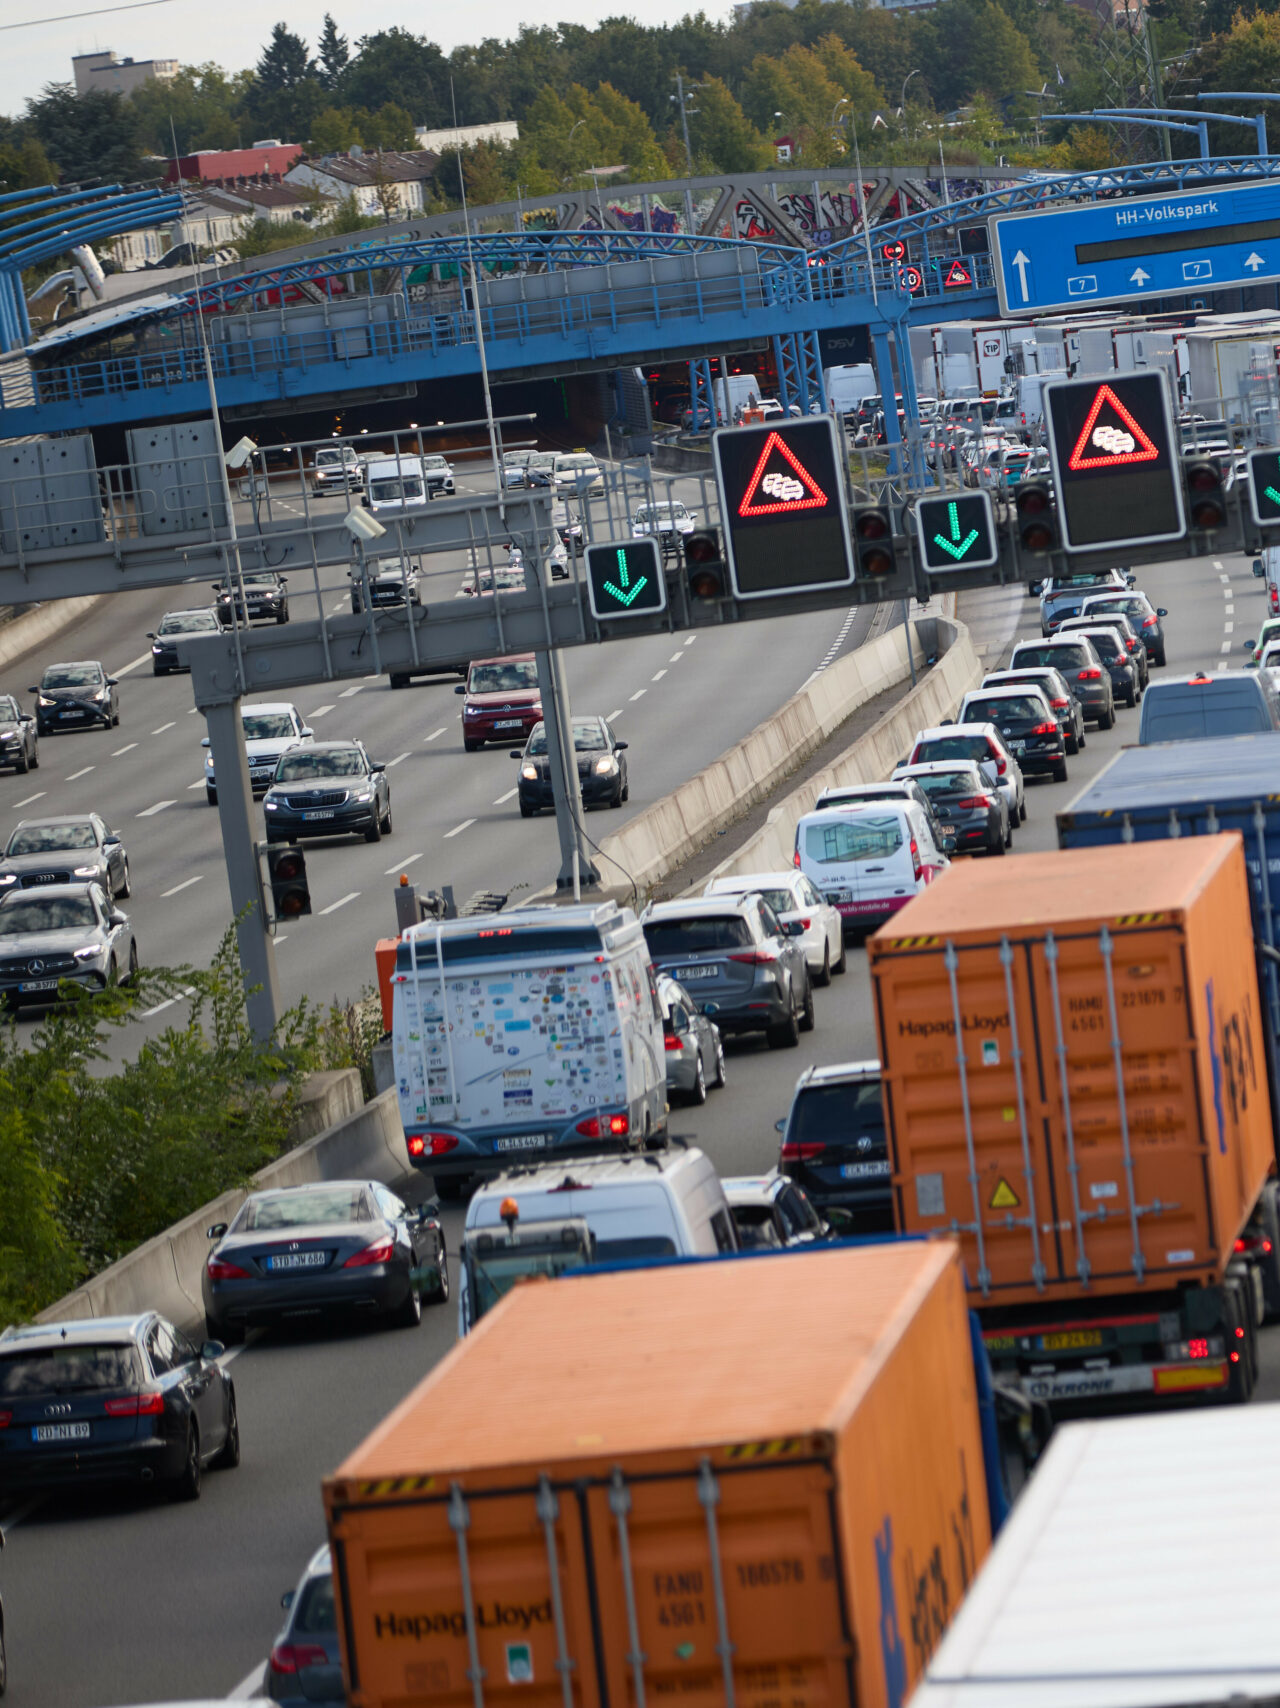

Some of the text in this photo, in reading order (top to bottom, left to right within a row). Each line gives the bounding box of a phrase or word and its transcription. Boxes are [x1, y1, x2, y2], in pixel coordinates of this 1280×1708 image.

[1115, 200, 1219, 227] HH-Volkspark
[827, 337, 857, 350] DSV
[985, 344, 999, 353] TIP
[899, 1013, 1011, 1037] HapagLloyd
[308, 1252, 324, 1265] 686
[1052, 1378, 1115, 1395] KRONE
[38, 1426, 53, 1440] RD
[75, 1424, 88, 1438] 89
[653, 1571, 704, 1597] FANU
[374, 1597, 553, 1642] HapagLloyd
